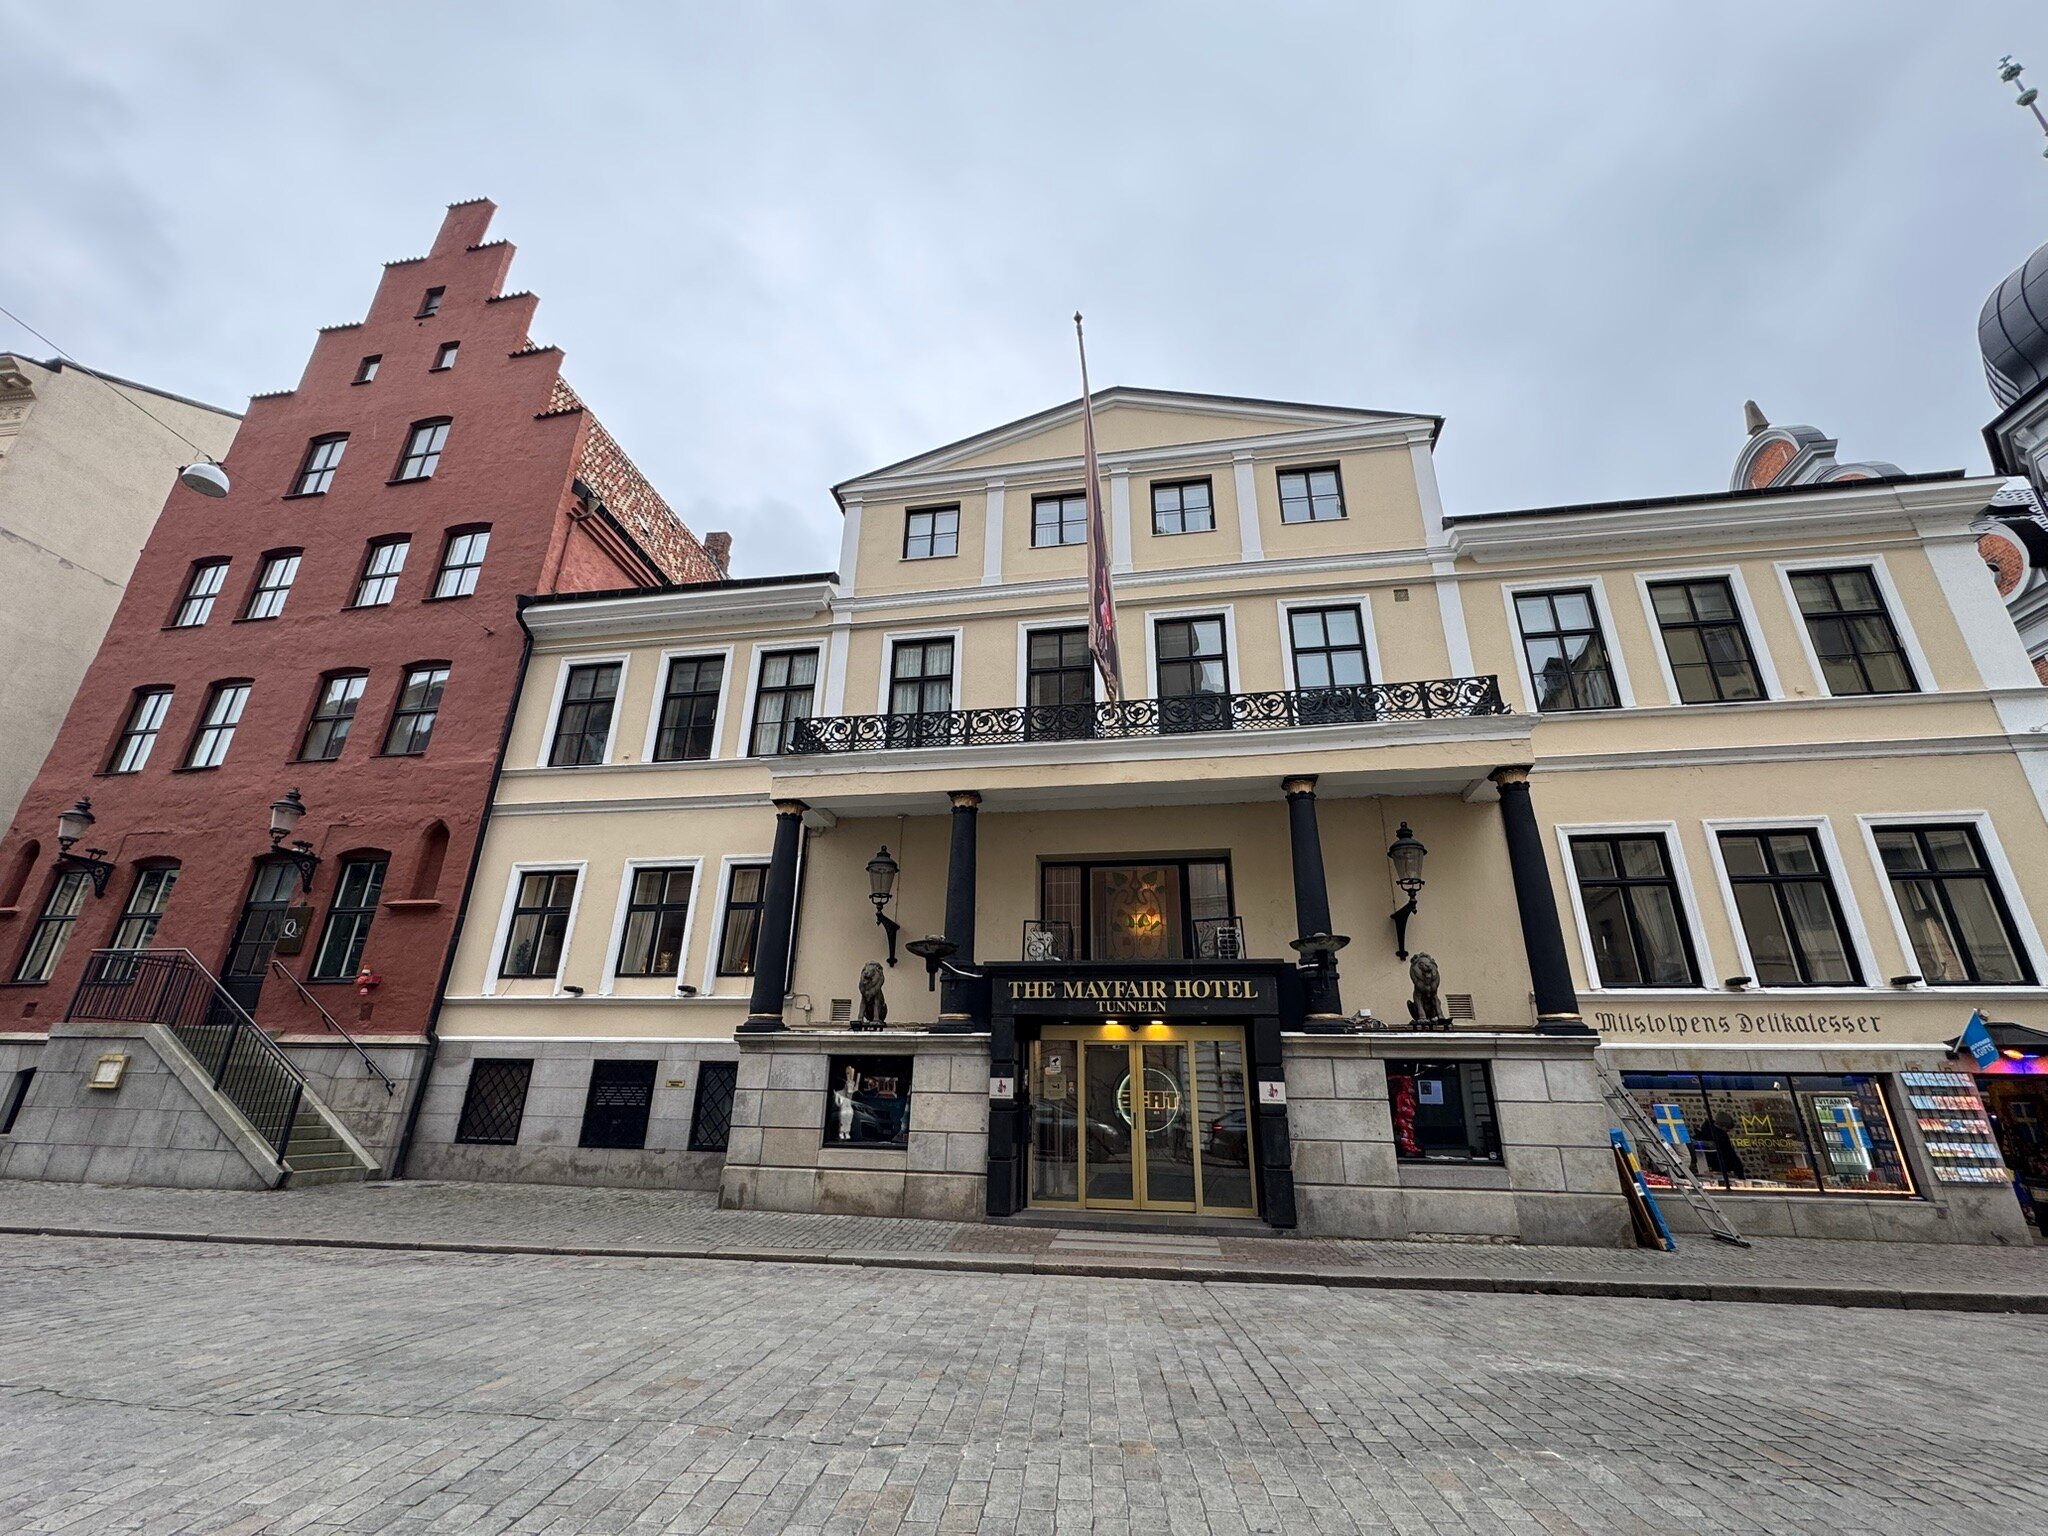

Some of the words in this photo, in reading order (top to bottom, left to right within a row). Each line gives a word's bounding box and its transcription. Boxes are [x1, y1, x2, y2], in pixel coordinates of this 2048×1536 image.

[1008, 981, 1056, 999] THE
[1062, 980, 1168, 998] MAYFAIR
[1174, 979, 1259, 998] HOTEL
[1096, 1001, 1166, 1012] TUNNELN
